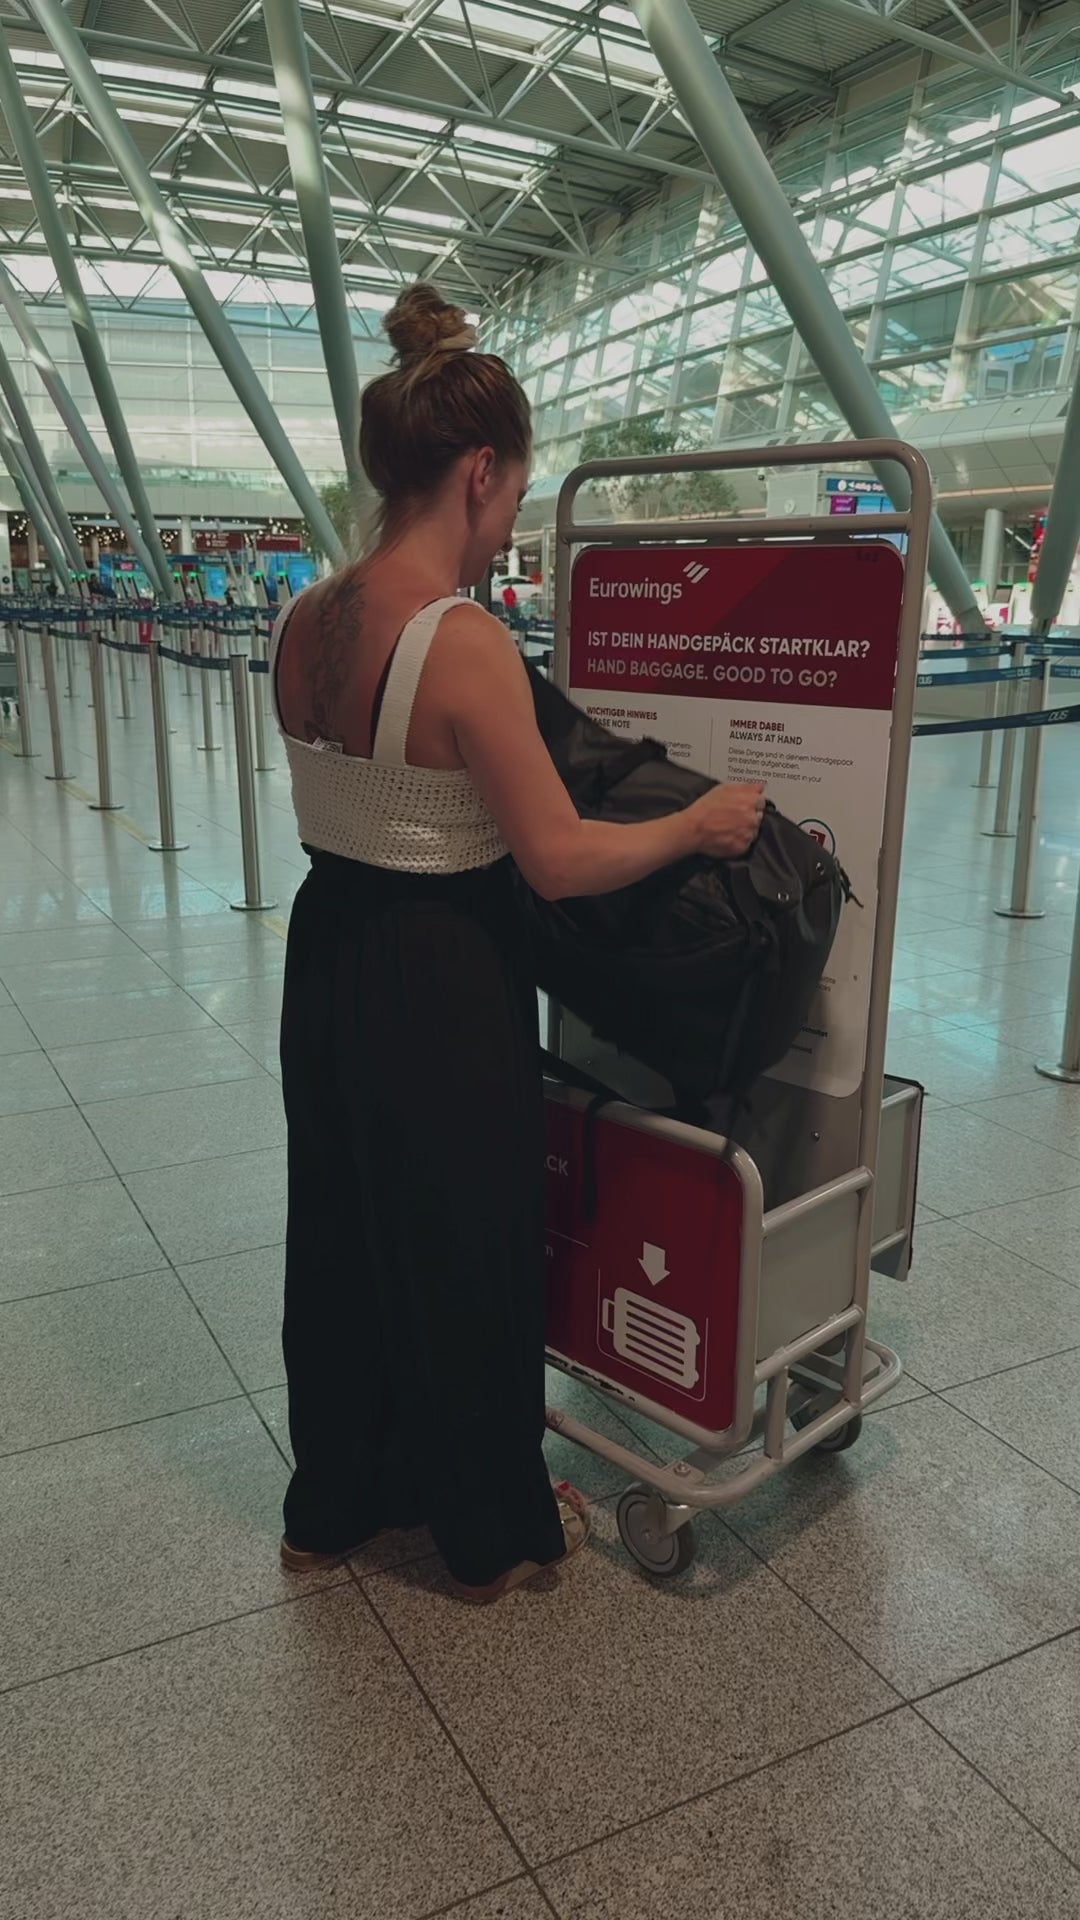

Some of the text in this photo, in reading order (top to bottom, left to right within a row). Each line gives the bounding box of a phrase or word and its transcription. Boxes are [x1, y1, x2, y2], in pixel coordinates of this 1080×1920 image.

[589, 577, 682, 605] Eurowings
[588, 631, 871, 658] IST DEIN HANDGEPÄCK STARTKLAR?
[587, 658, 838, 688] HAND BAGGAGE. GOOD TO GO?
[586, 706, 658, 721] WICHTIGER HINWEIS
[612, 719, 631, 729] NOTE
[730, 719, 785, 732] IMMER DABEI
[729, 731, 803, 745] ALWAYS AT HAND
[746, 748, 764, 759] Dinge
[772, 771, 786, 779] best
[543, 1154, 569, 1177] CK
